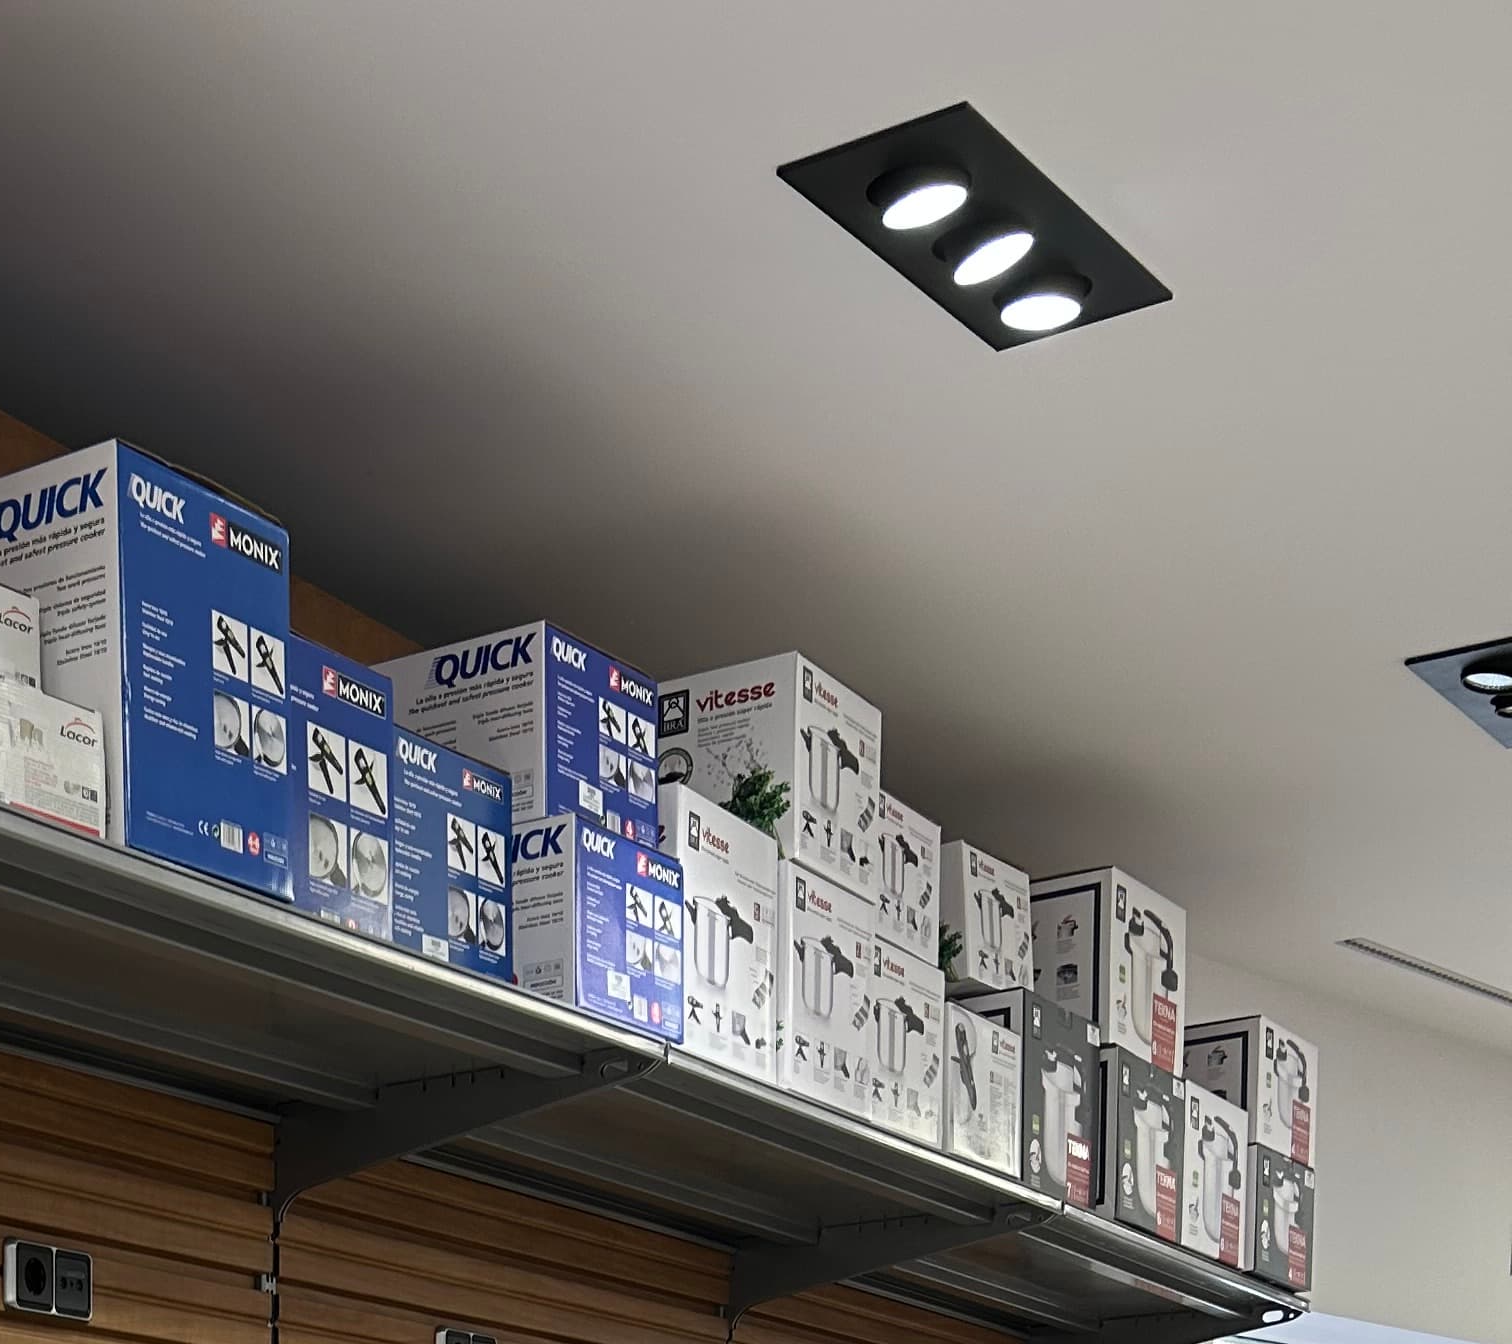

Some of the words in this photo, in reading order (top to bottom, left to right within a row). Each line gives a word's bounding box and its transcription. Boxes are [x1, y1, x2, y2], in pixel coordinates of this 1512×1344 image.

[129, 472, 186, 525] QUICK
[229, 528, 281, 571] MONIX
[433, 632, 537, 688] QUICK
[551, 635, 587, 672] QUICK
[338, 679, 384, 714] MONIX
[620, 678, 653, 708] MONIX
[696, 681, 776, 713] vitesse
[814, 680, 839, 709] vitesse
[60, 722, 99, 748] Lacor
[397, 736, 437, 774] QUICK
[474, 778, 503, 801] MONIX
[511, 823, 568, 864] ICK
[581, 827, 615, 860] QUICK
[702, 826, 730, 855] vitesse
[647, 858, 681, 888] MONIX
[807, 890, 833, 914] vitesse
